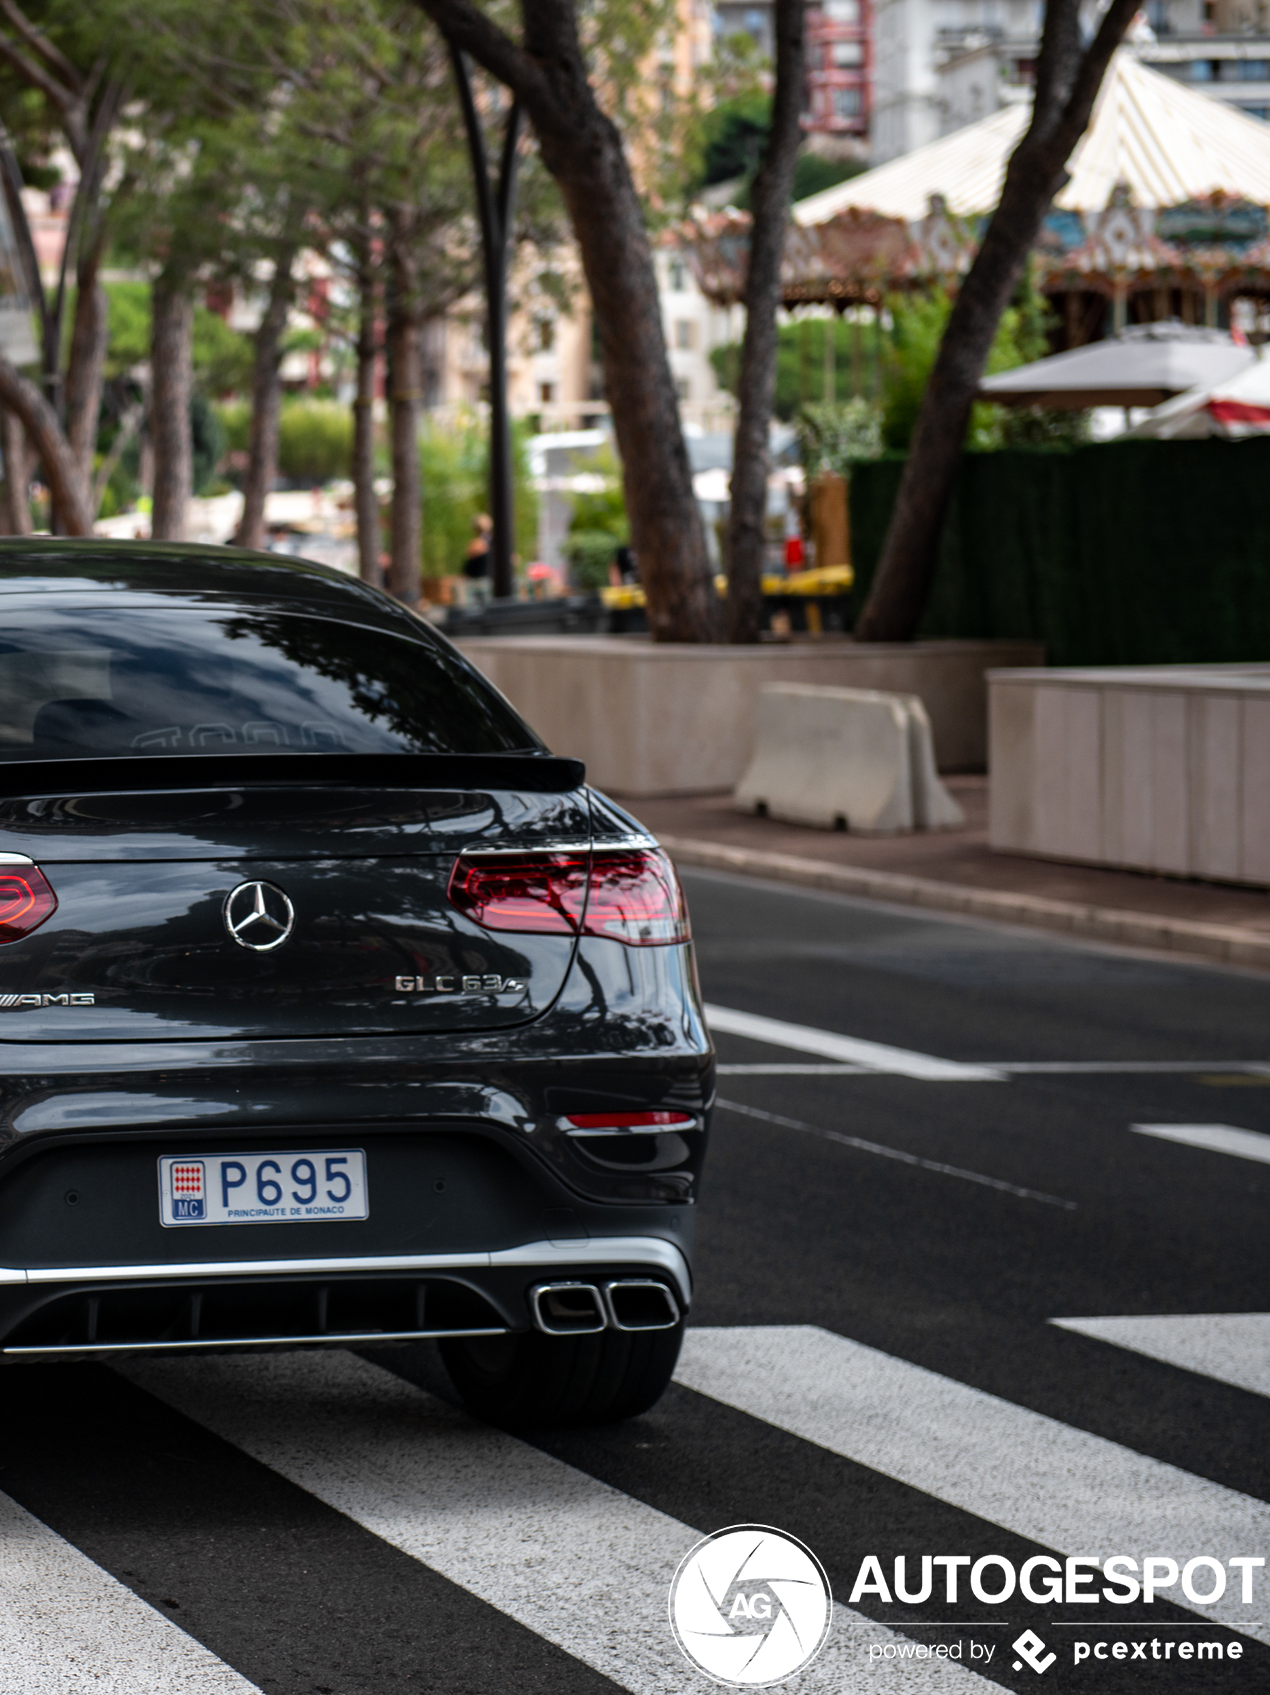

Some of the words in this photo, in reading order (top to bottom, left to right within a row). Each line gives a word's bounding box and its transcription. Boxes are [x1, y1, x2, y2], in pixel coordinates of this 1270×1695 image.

[395, 975, 454, 992] GLC
[220, 1157, 352, 1208] P695
[178, 1201, 198, 1217] MC
[228, 1208, 287, 1218] PRINCIPAUTE
[290, 1207, 302, 1215] DE
[305, 1206, 345, 1215] MONACO
